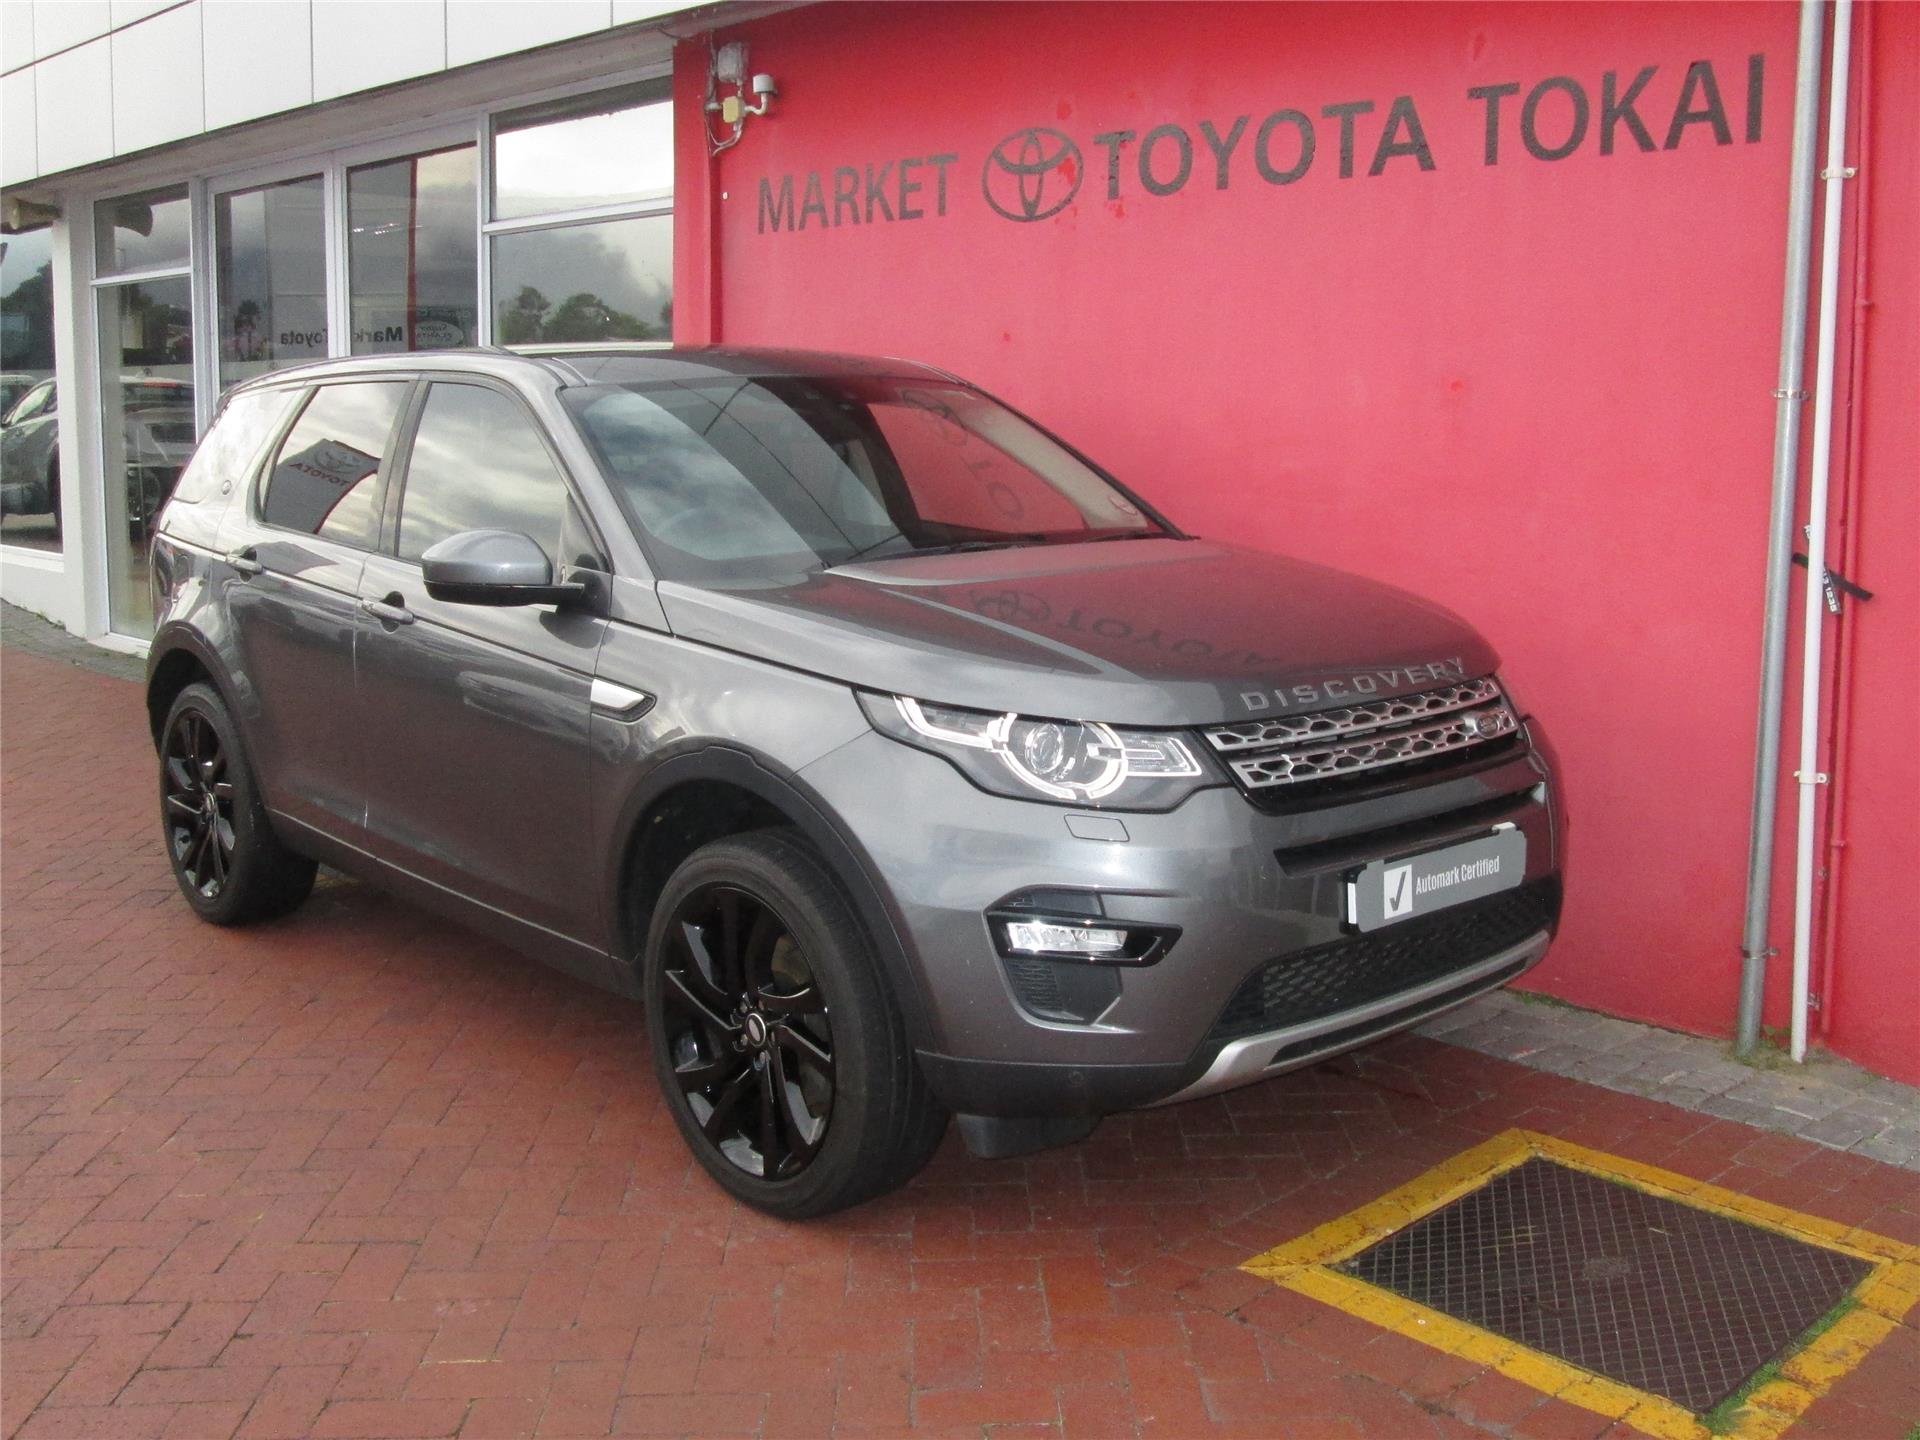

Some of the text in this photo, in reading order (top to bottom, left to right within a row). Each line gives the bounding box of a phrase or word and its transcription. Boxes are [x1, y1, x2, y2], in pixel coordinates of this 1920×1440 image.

[757, 54, 1764, 234] MARKET TOYOTA TOKAI
[1240, 657, 1465, 711] DISCOVERY
[1416, 855, 1500, 895] Automark Certified
